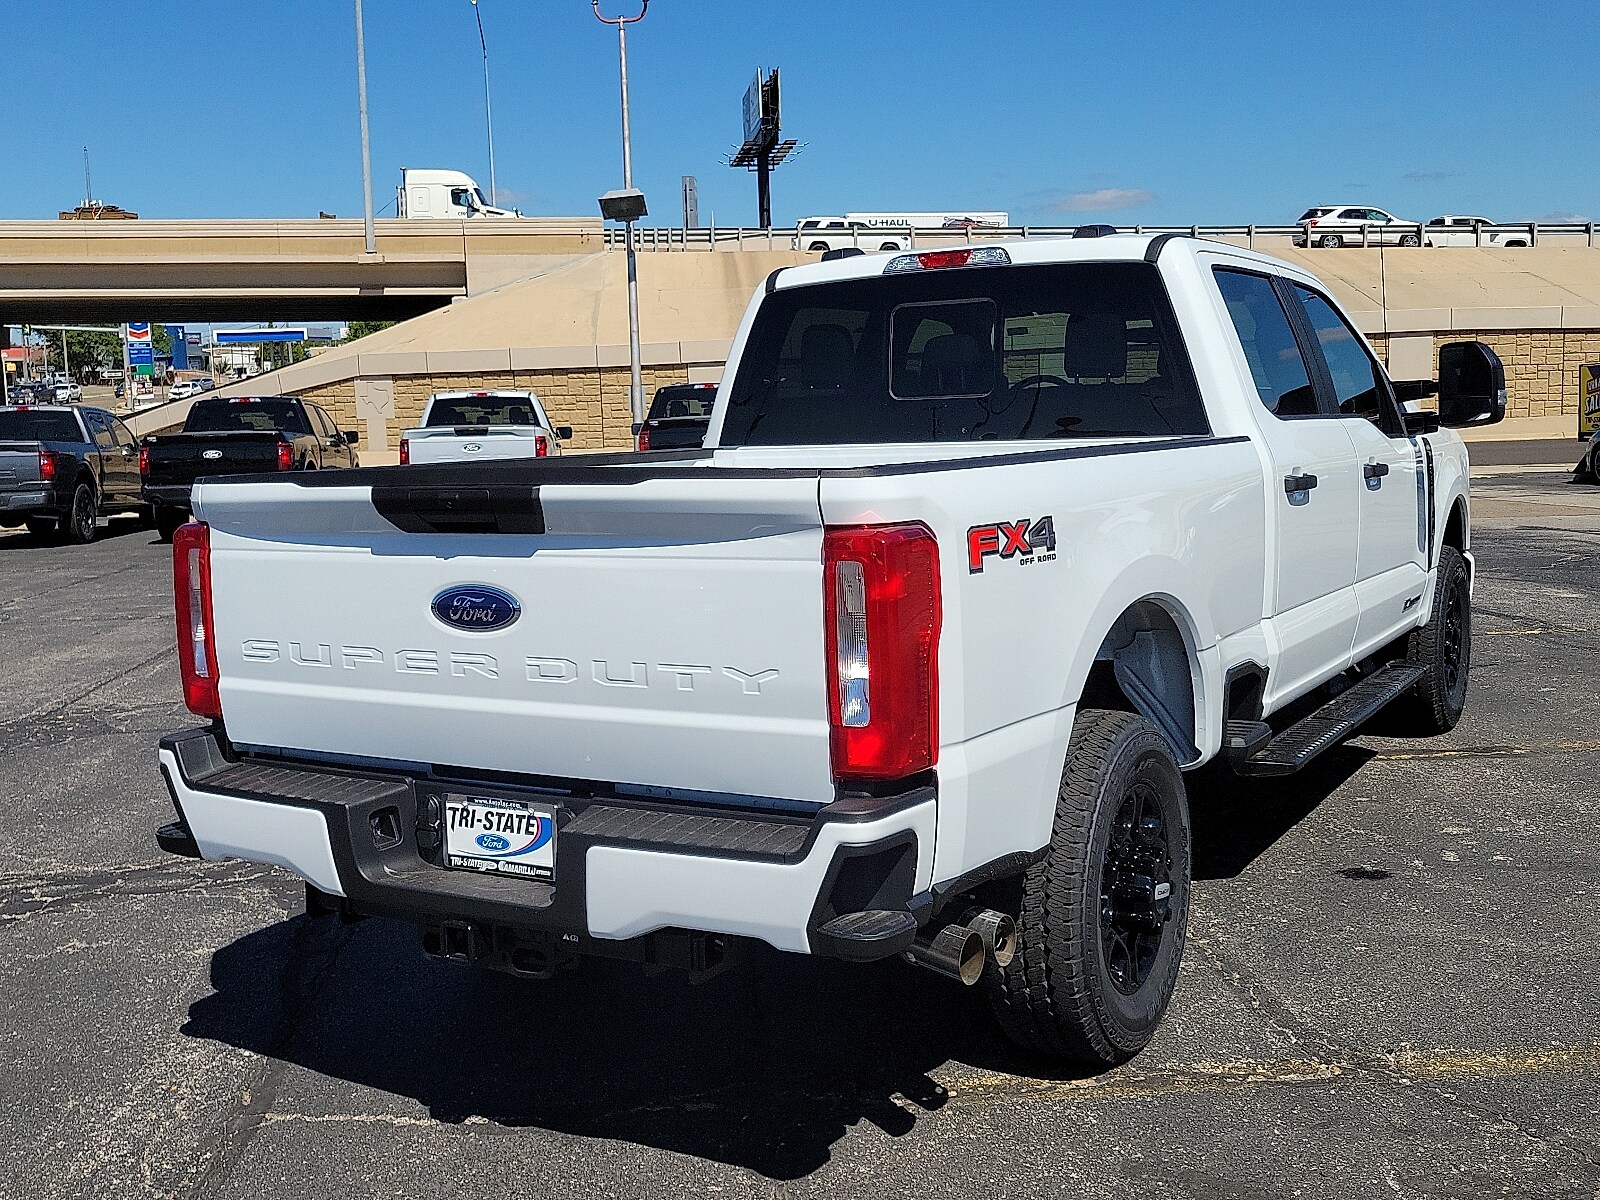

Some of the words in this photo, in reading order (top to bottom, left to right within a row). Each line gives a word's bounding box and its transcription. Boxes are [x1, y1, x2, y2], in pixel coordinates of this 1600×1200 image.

[868, 219, 911, 227] U-HAUL
[1585, 393, 1600, 414] SAL
[966, 515, 1057, 575] FX4
[1019, 556, 1035, 566] OFF
[1037, 553, 1057, 563] ROAD
[449, 595, 497, 622] Ford
[241, 638, 499, 680] SUPER
[525, 655, 781, 696] DUTY
[447, 806, 537, 836] TRI-STATE
[481, 835, 504, 849] Ford
